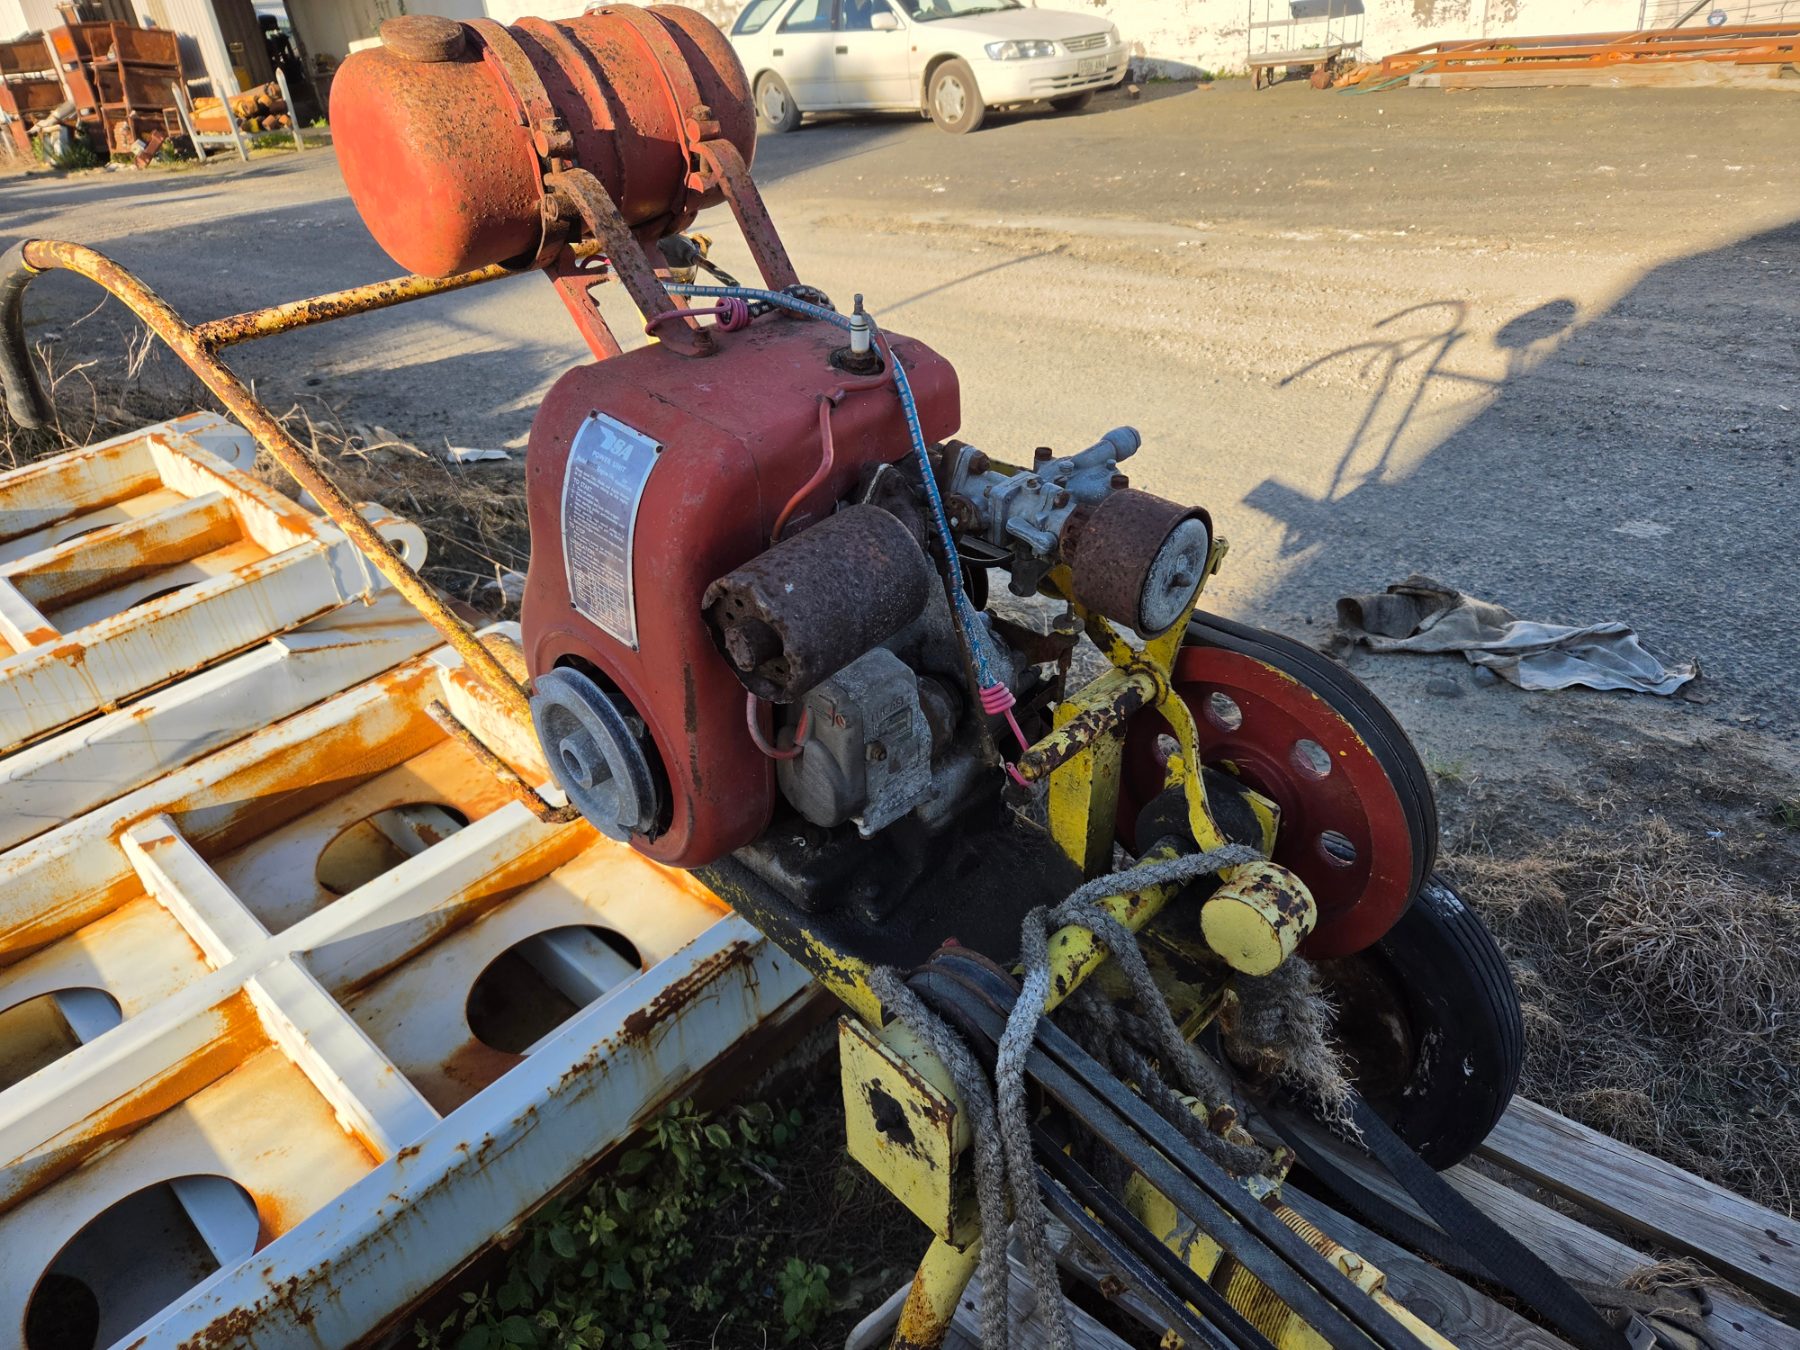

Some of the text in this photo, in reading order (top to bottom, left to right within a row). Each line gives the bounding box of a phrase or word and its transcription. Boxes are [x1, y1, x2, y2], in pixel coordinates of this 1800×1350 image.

[600, 426, 634, 461] BSA
[592, 450, 627, 473] POWER UNIT
